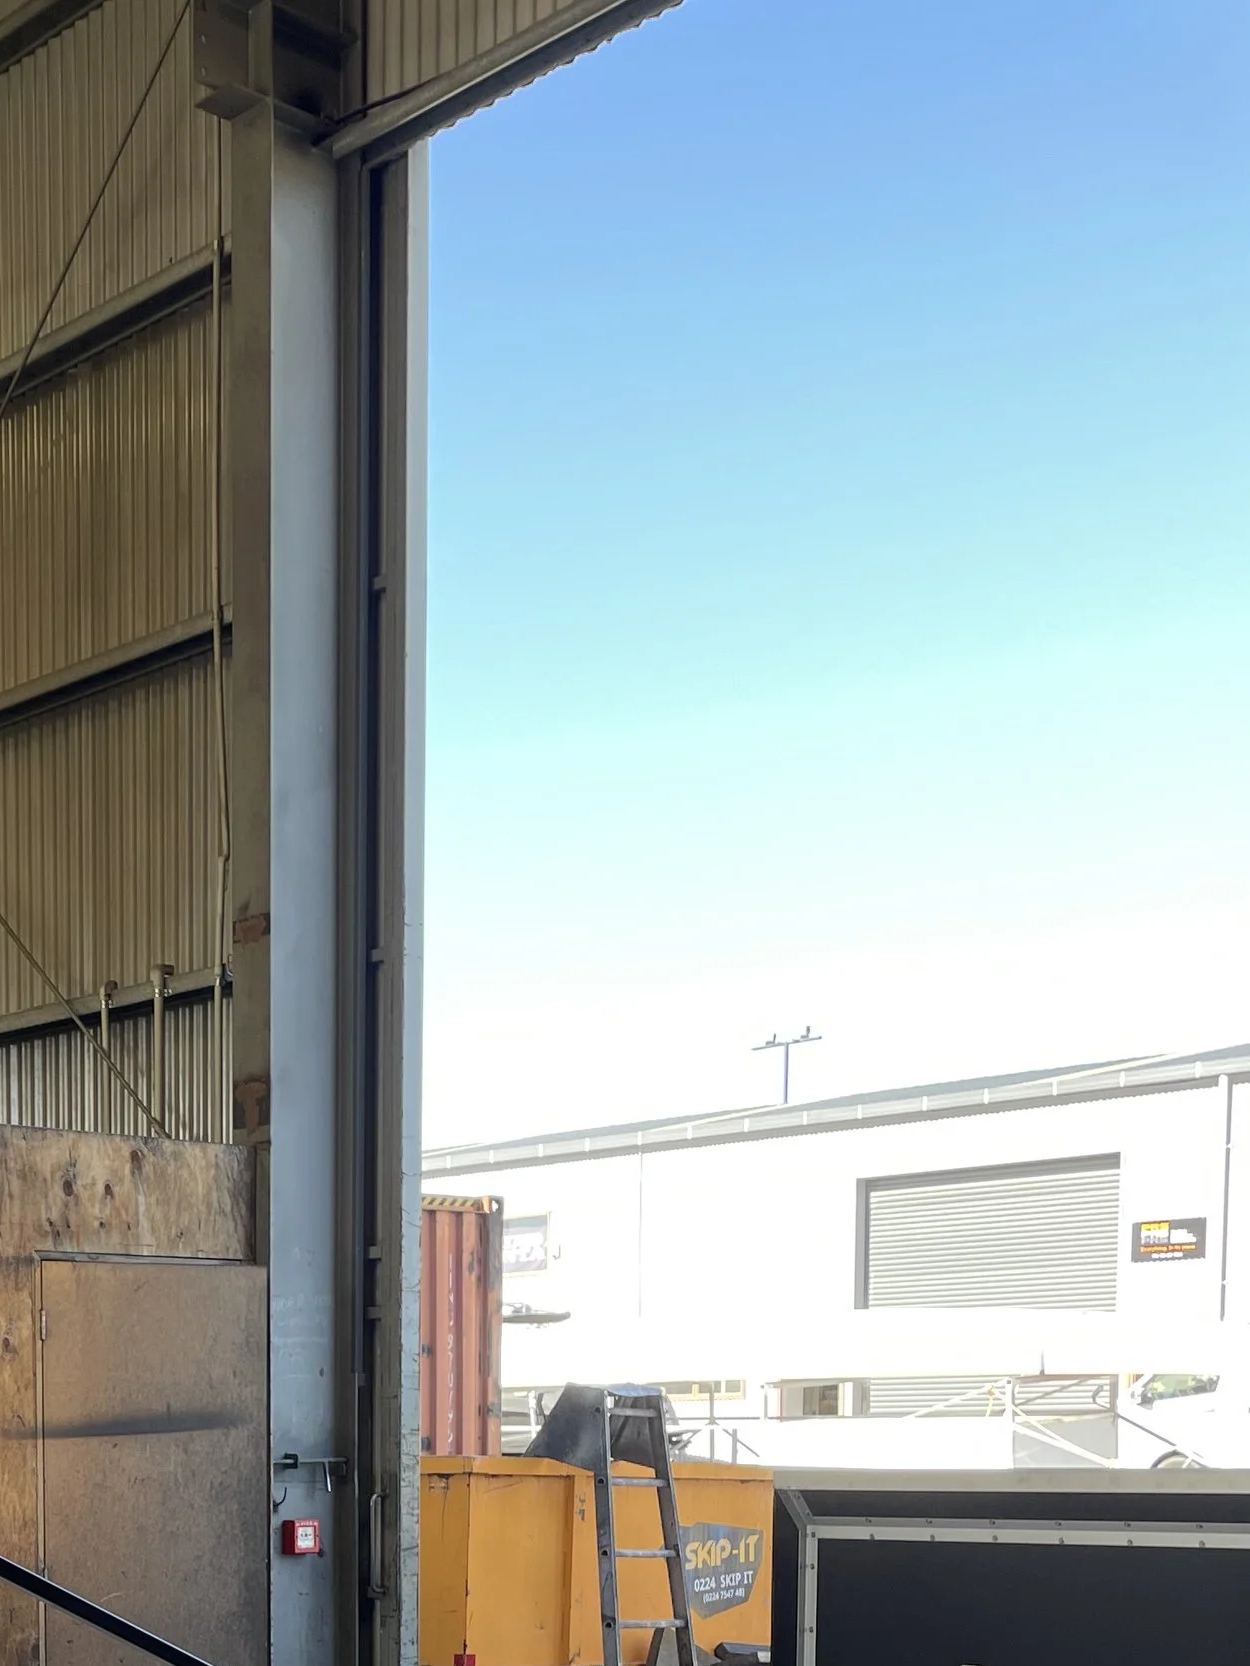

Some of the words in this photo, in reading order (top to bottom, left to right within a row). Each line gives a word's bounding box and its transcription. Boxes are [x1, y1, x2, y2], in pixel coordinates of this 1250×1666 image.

[685, 1534, 759, 1570] SKIP-IT
[694, 1576, 716, 1592] 0224
[720, 1573, 741, 1588] SKIP
[743, 1571, 753, 1585] IT
